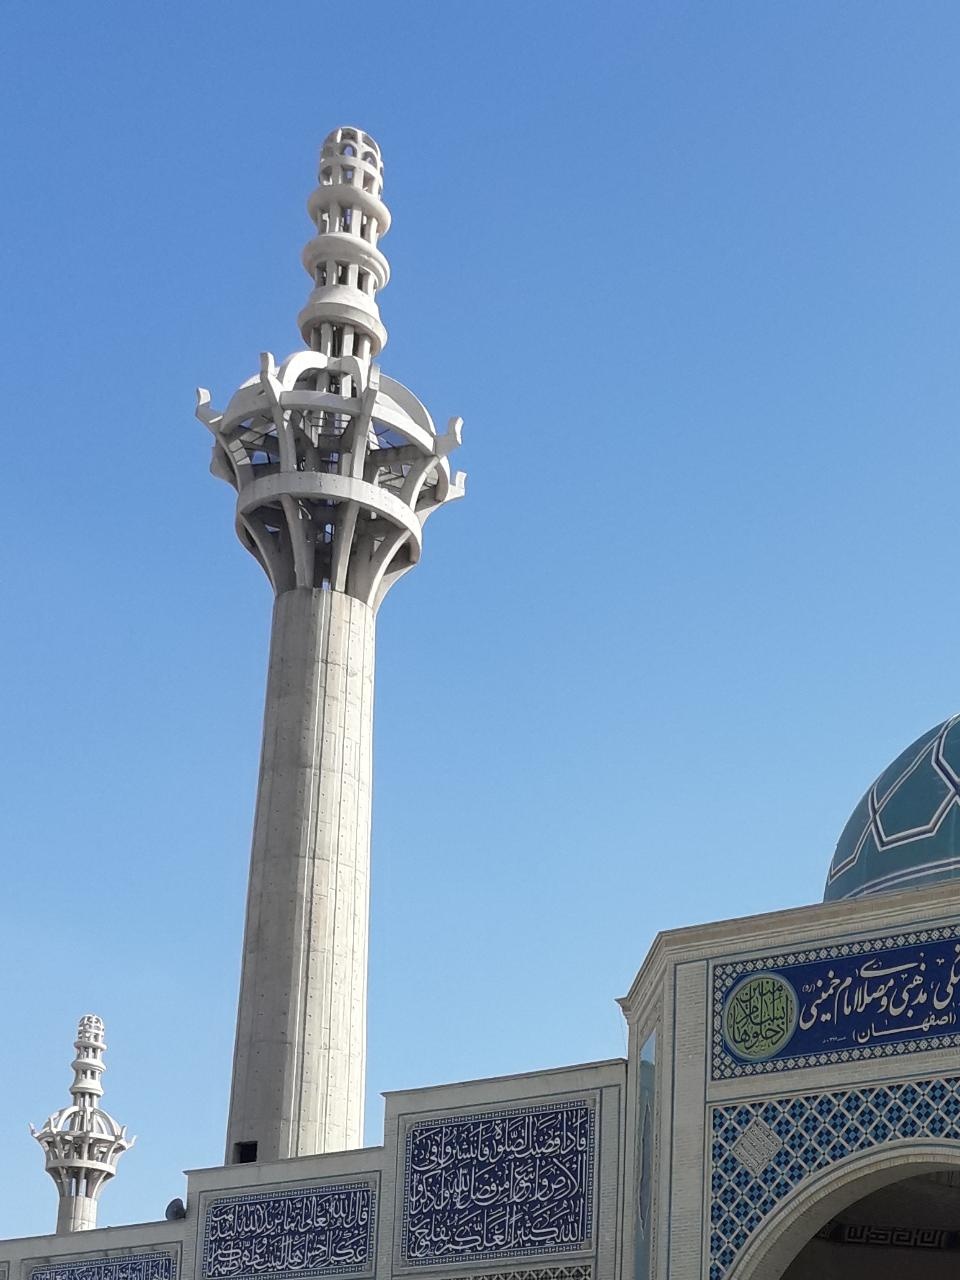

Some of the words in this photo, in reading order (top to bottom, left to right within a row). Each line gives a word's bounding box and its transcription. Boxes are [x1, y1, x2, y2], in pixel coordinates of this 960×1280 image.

[799, 970, 841, 1030] خمینی
[834, 977, 859, 1025] امام
[877, 996, 888, 1013] و
[889, 963, 927, 1018] مذهبی
